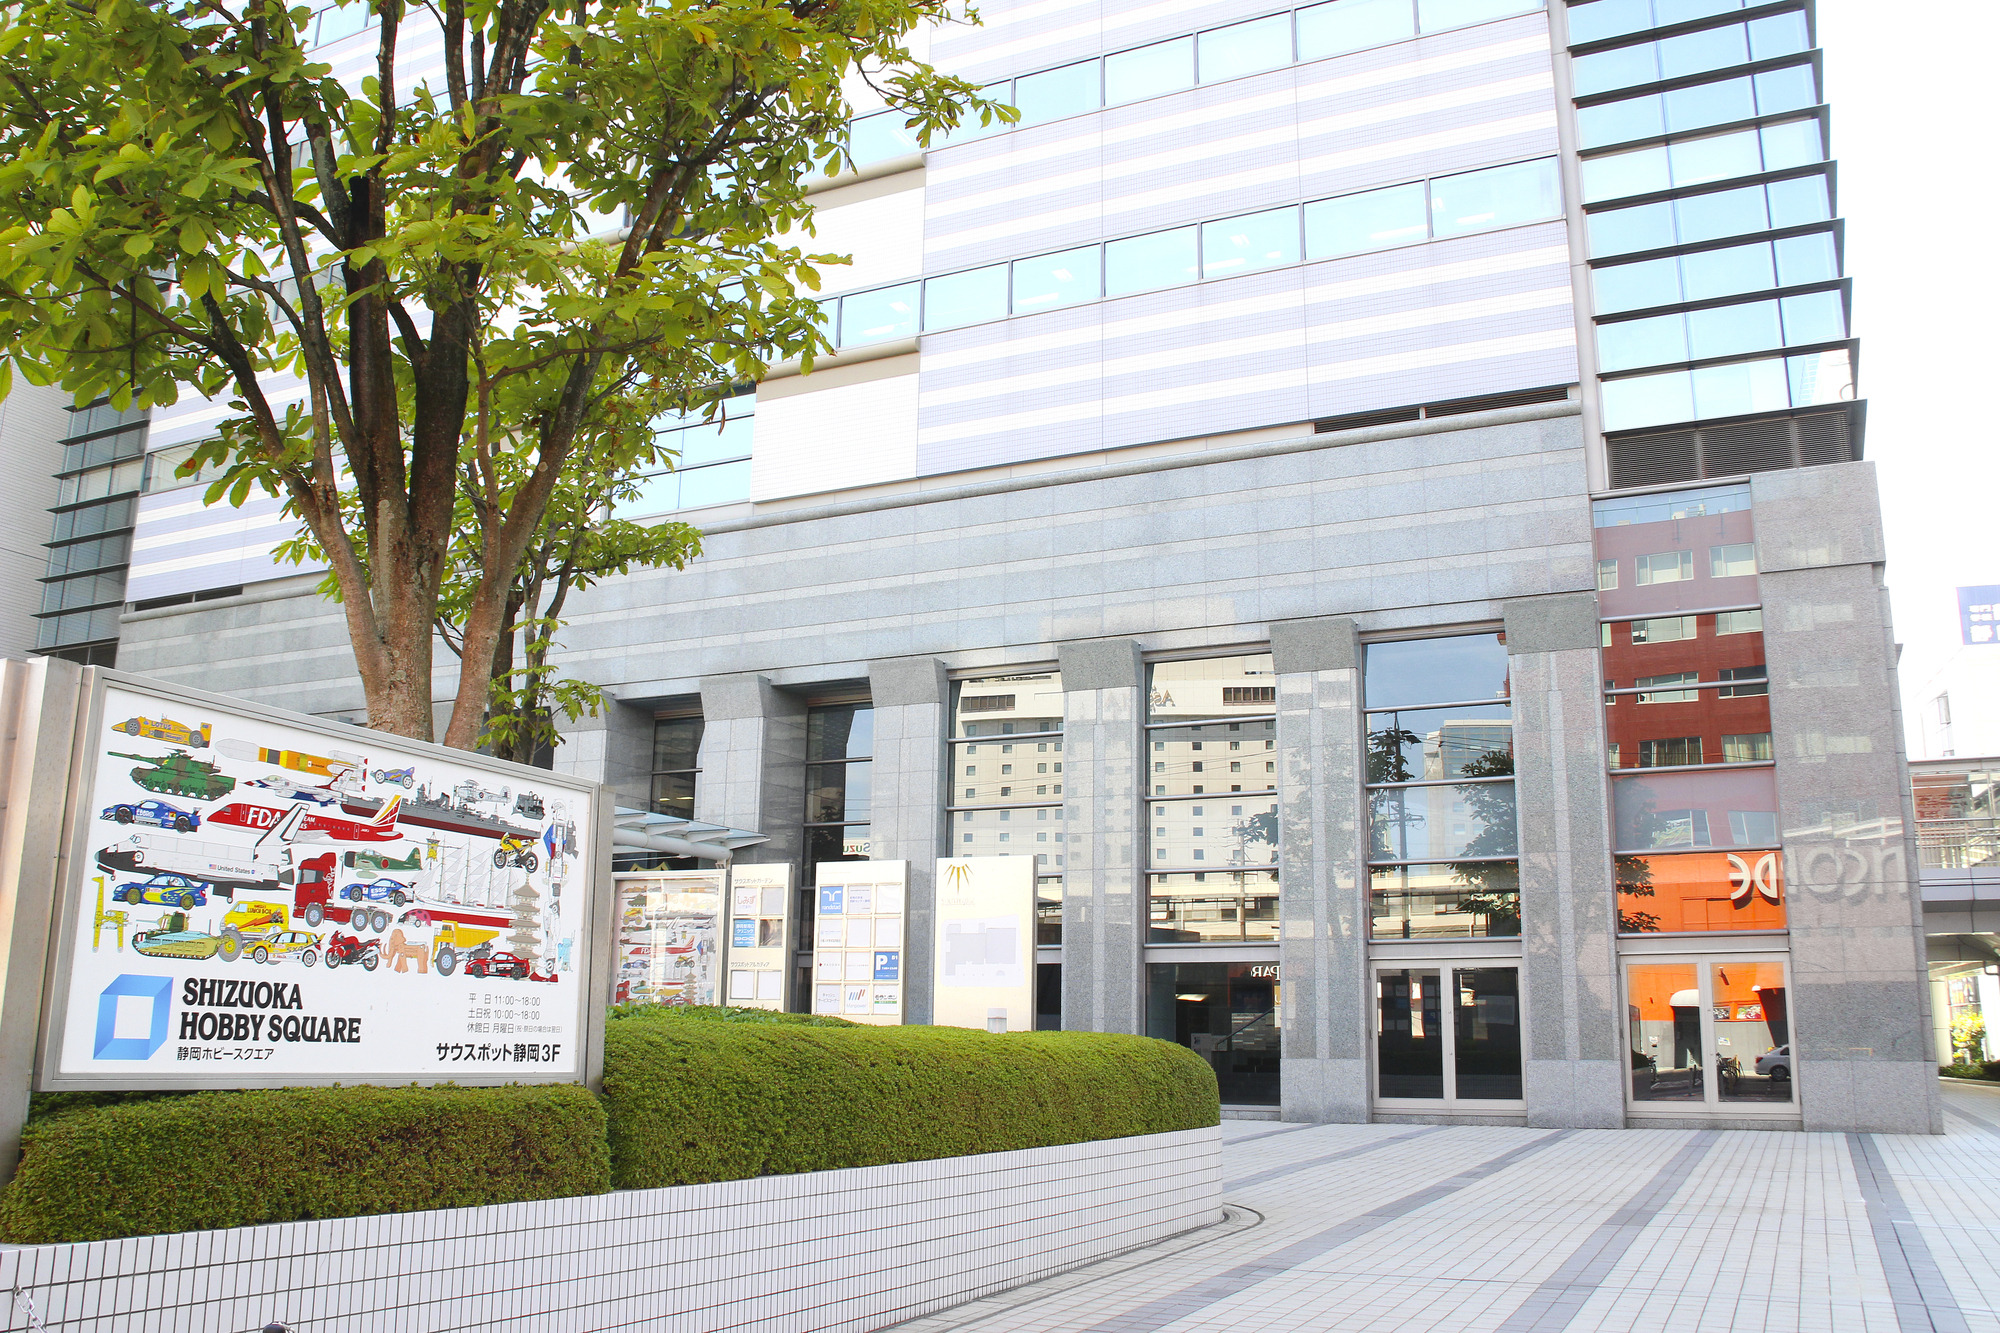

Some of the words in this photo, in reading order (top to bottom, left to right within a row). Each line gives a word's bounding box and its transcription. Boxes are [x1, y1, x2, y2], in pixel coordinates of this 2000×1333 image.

[217, 864, 234, 873] United
[235, 866, 250, 874] States
[183, 977, 303, 1010] SHIZUOKA
[468, 1008, 491, 1019] 土日祝
[179, 1012, 265, 1041] HOBBY
[267, 1014, 361, 1043] SQUARE
[467, 1022, 490, 1033] 休館日
[177, 1046, 274, 1060] 静岡ホビースクエア
